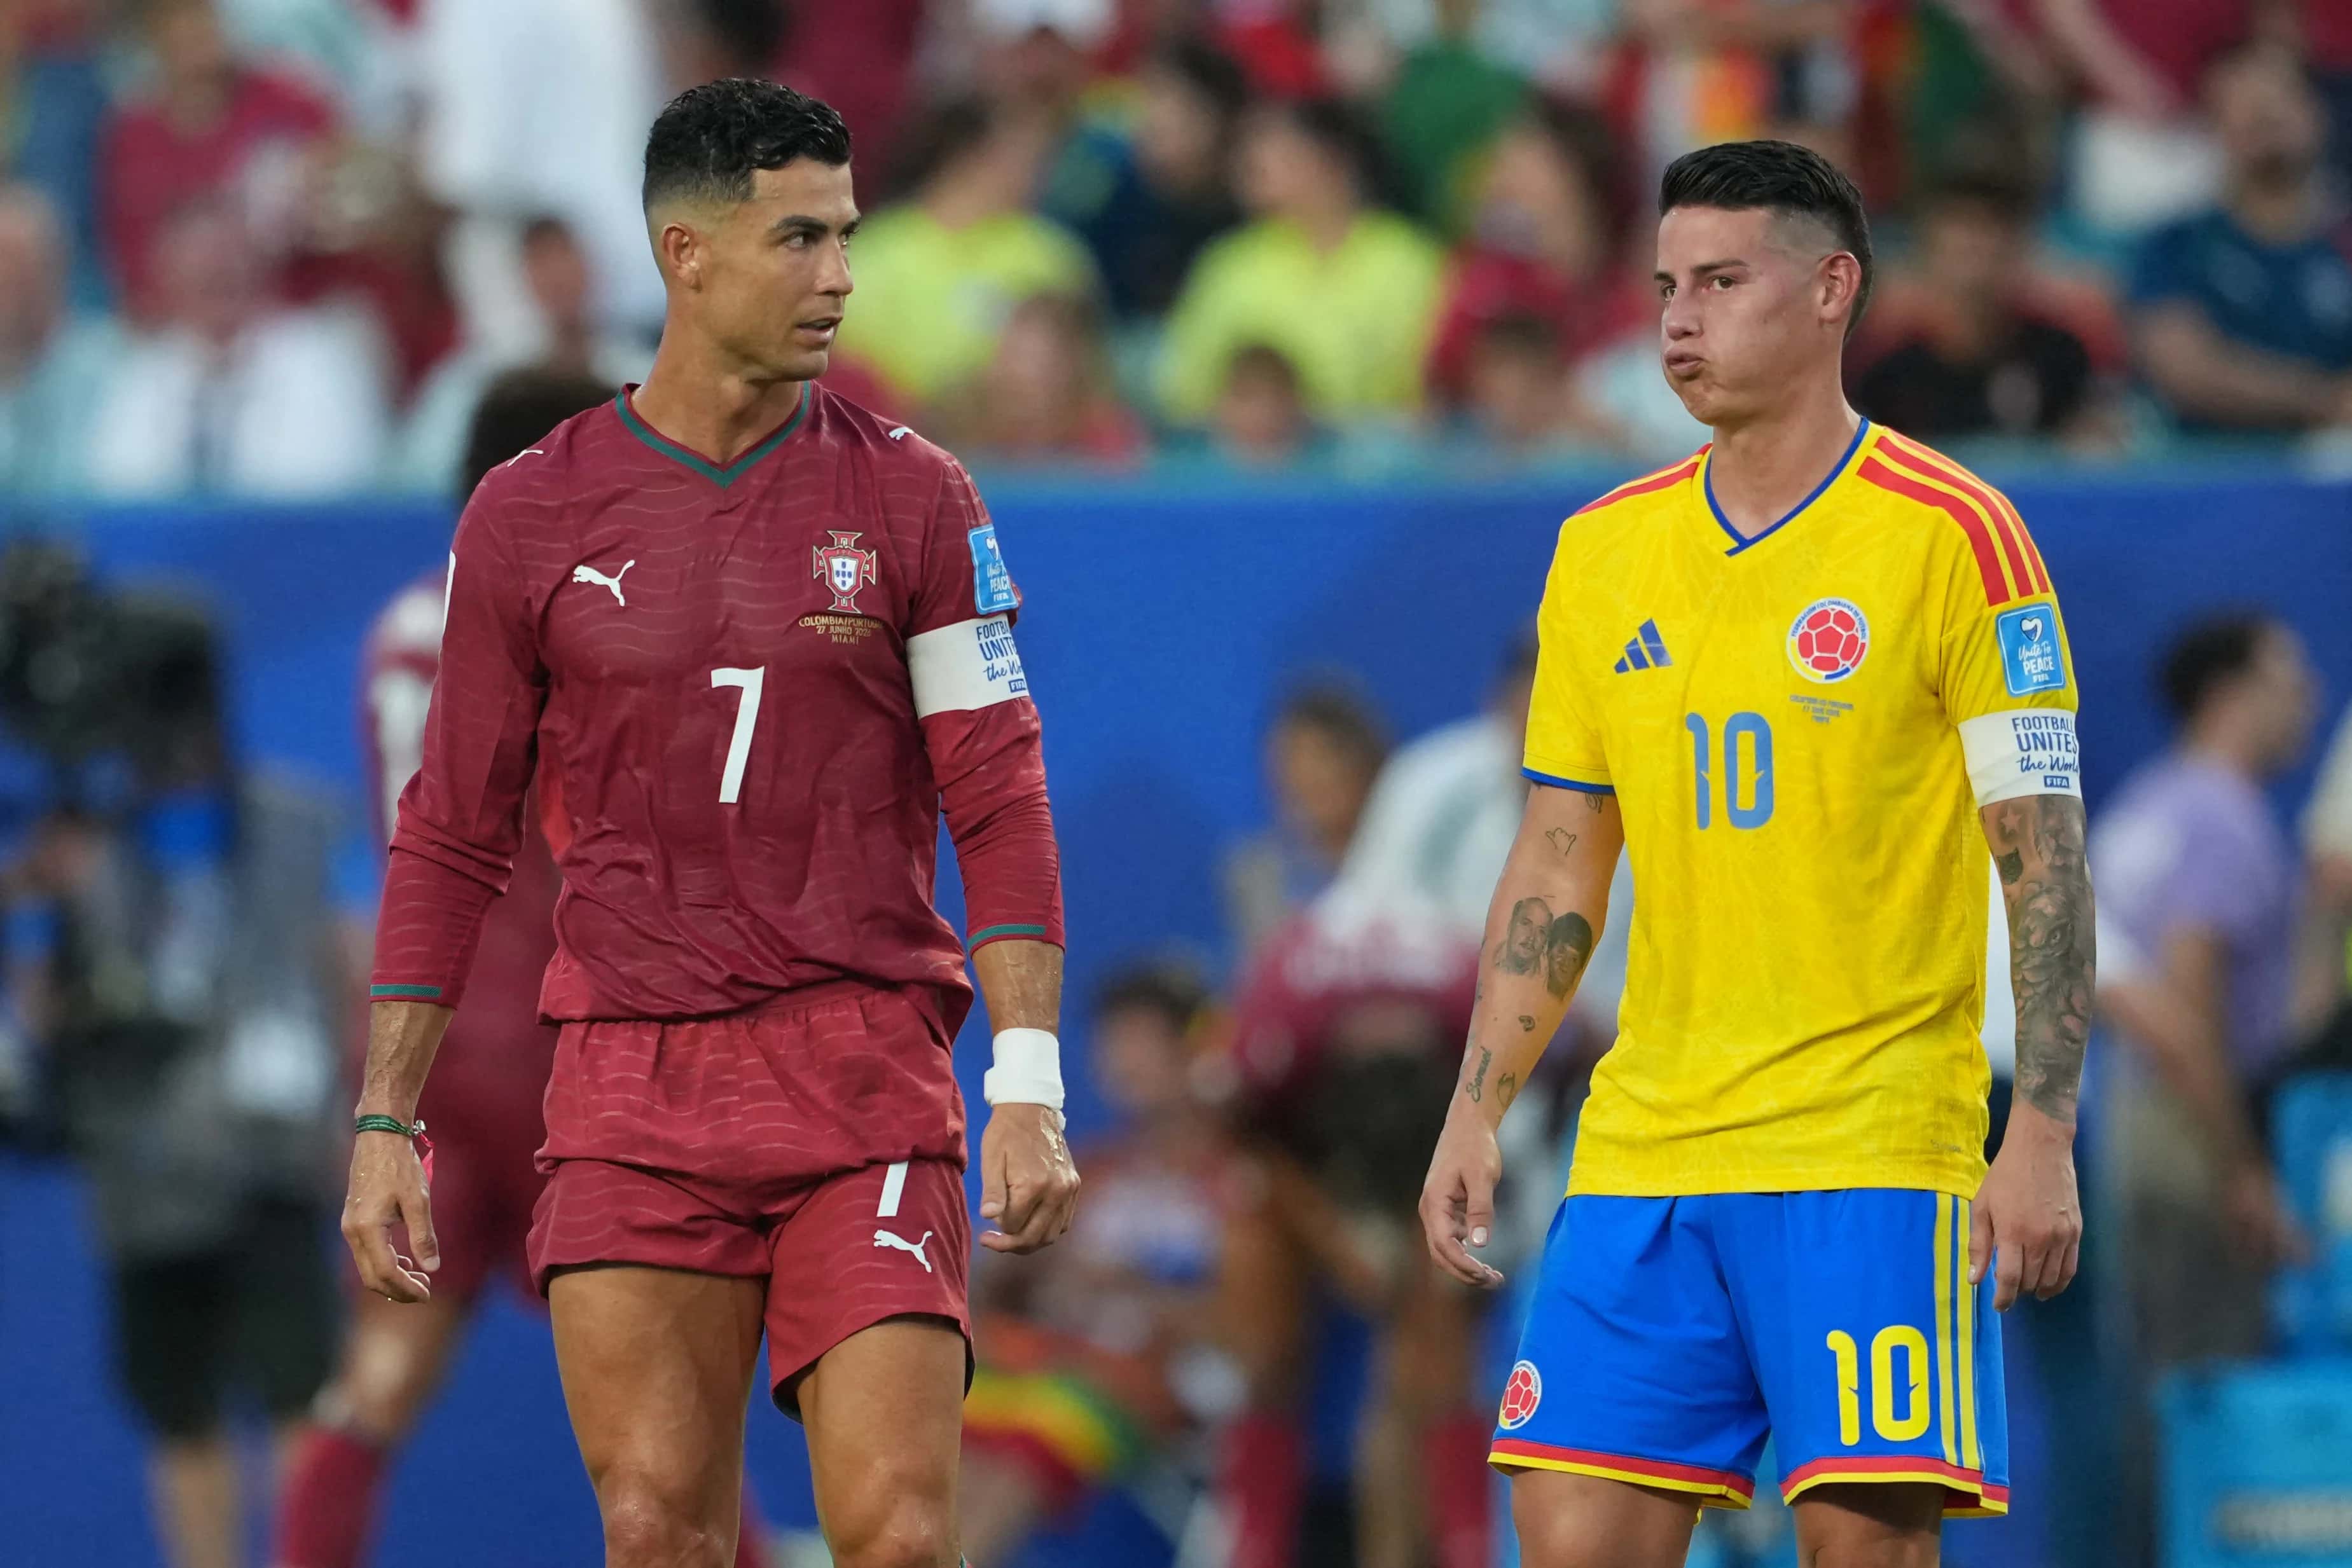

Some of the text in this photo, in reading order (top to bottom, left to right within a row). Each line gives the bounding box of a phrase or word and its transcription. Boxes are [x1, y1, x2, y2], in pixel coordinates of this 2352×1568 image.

[816, 625, 826, 635] 27
[828, 626, 852, 635] JUNHO
[831, 634, 859, 645] MIAMI
[983, 663, 1007, 682] the
[2023, 656, 2055, 676] PEACE
[2012, 716, 2073, 732] FOOTBALL
[710, 666, 765, 803] 7
[2016, 732, 2078, 755] UNITES
[1685, 712, 1775, 830] 10
[2016, 754, 2047, 773] the
[2046, 778, 2068, 787] FIFA
[1826, 1324, 1930, 1446] 10
